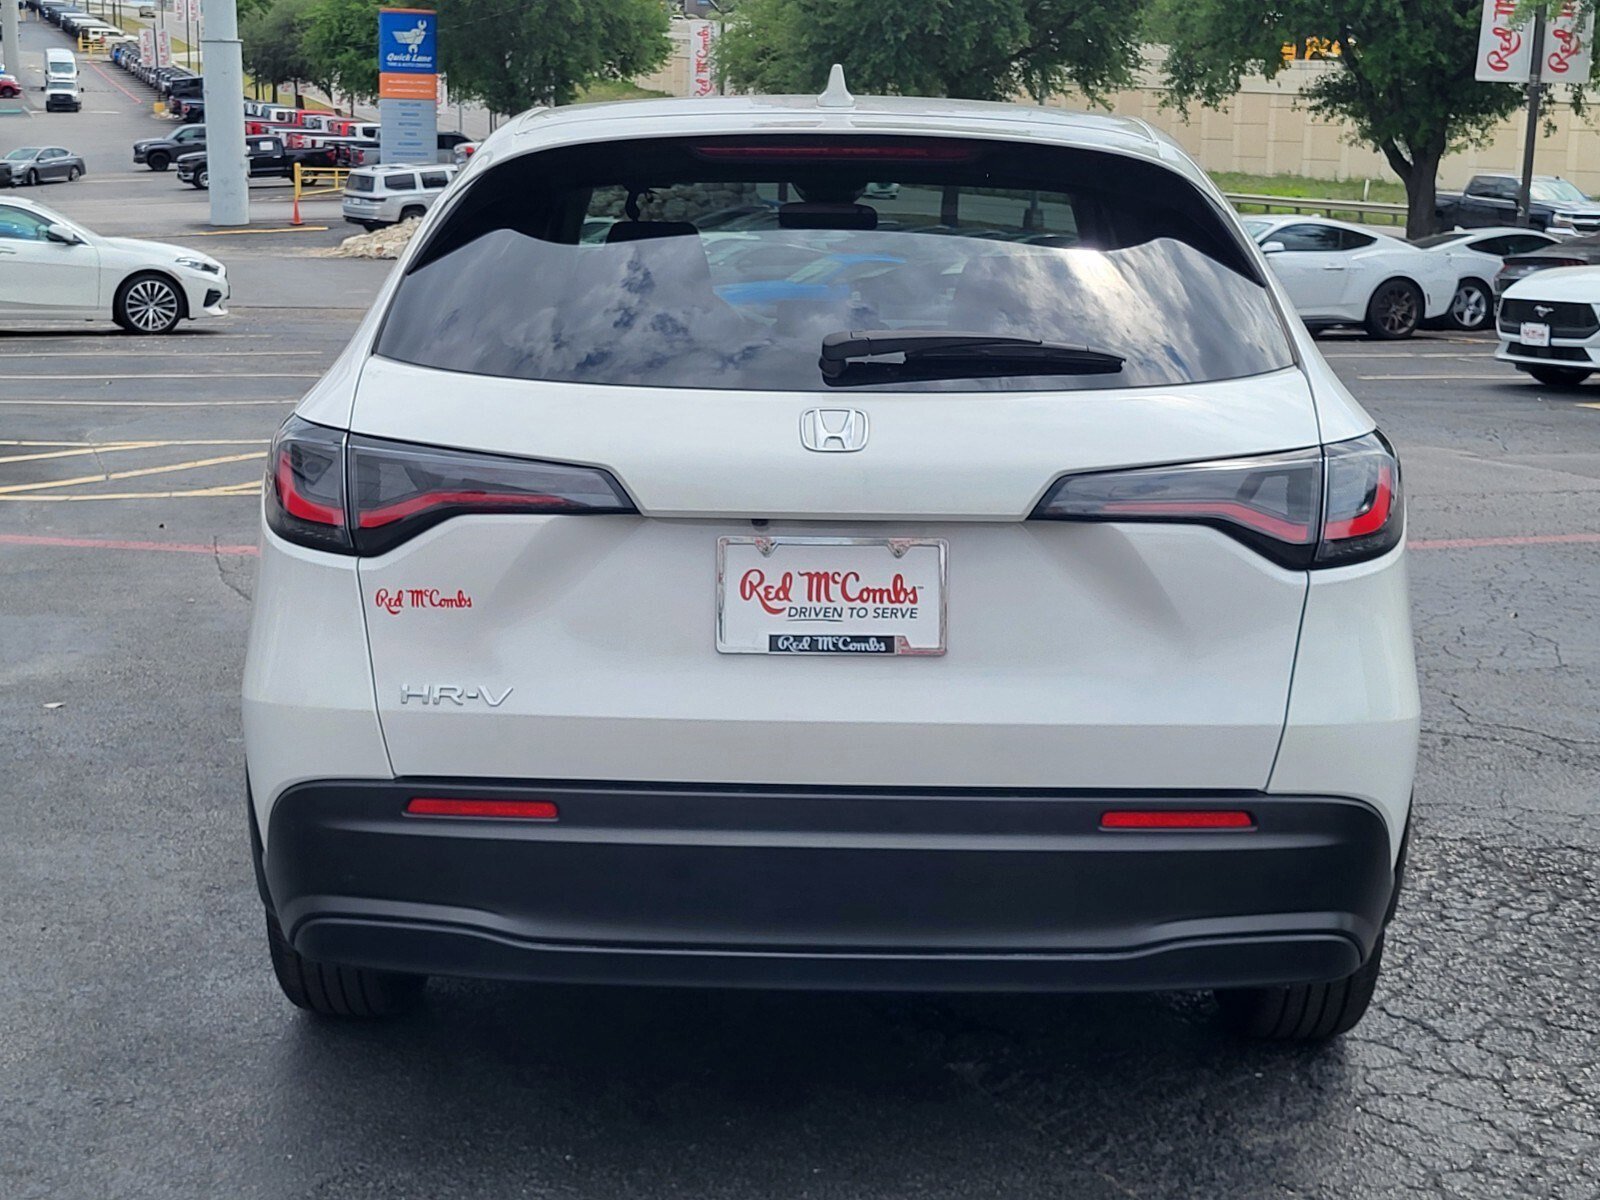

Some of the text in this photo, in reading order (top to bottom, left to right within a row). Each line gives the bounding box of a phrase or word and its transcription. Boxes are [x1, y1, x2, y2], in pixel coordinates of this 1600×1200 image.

[387, 53, 432, 62] Quick Lane
[1486, 26, 1521, 72] Red
[1547, 28, 1581, 73] Red
[375, 587, 472, 615] Red McCombs
[740, 568, 918, 615] Red McCombs
[787, 606, 918, 619] DRIVEN TO SERVE
[777, 635, 886, 653] Red McCombs
[401, 683, 514, 708] HR-V
